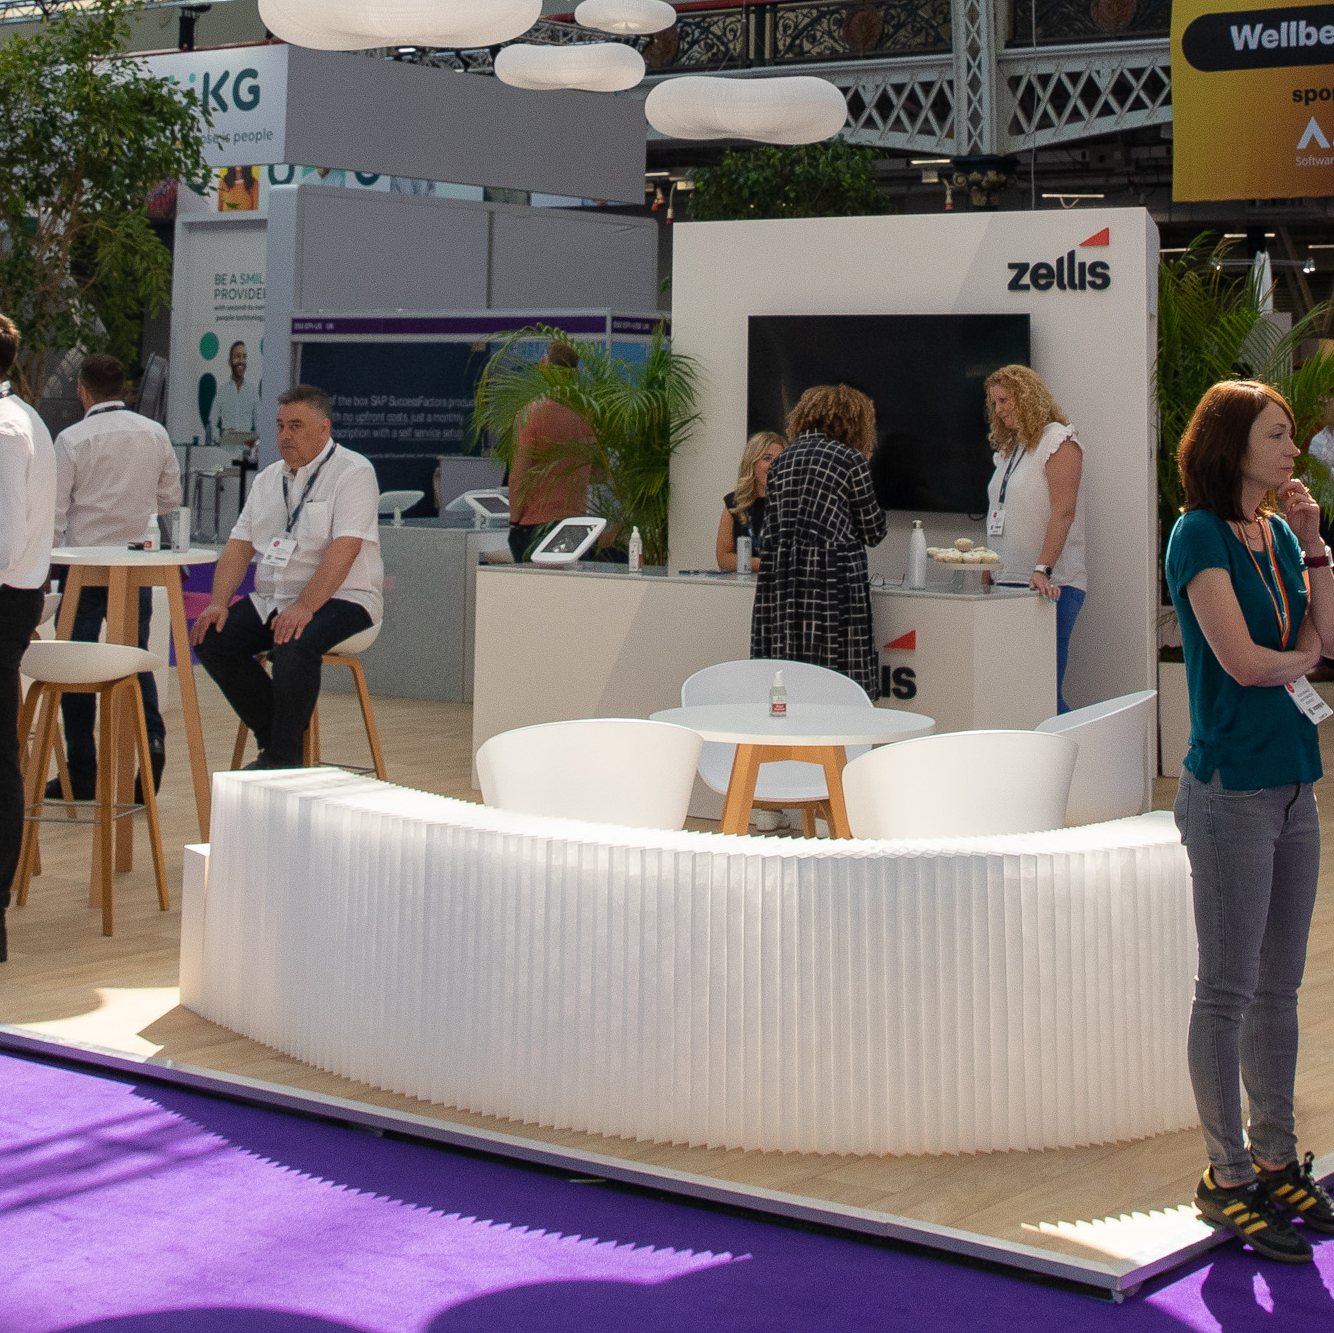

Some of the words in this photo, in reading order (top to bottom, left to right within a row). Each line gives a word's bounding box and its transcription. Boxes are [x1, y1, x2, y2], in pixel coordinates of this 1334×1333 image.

[170, 67, 261, 113] KG
[233, 127, 274, 145] people
[214, 273, 228, 286] BE
[229, 273, 238, 284] A
[370, 395, 388, 407] SAP
